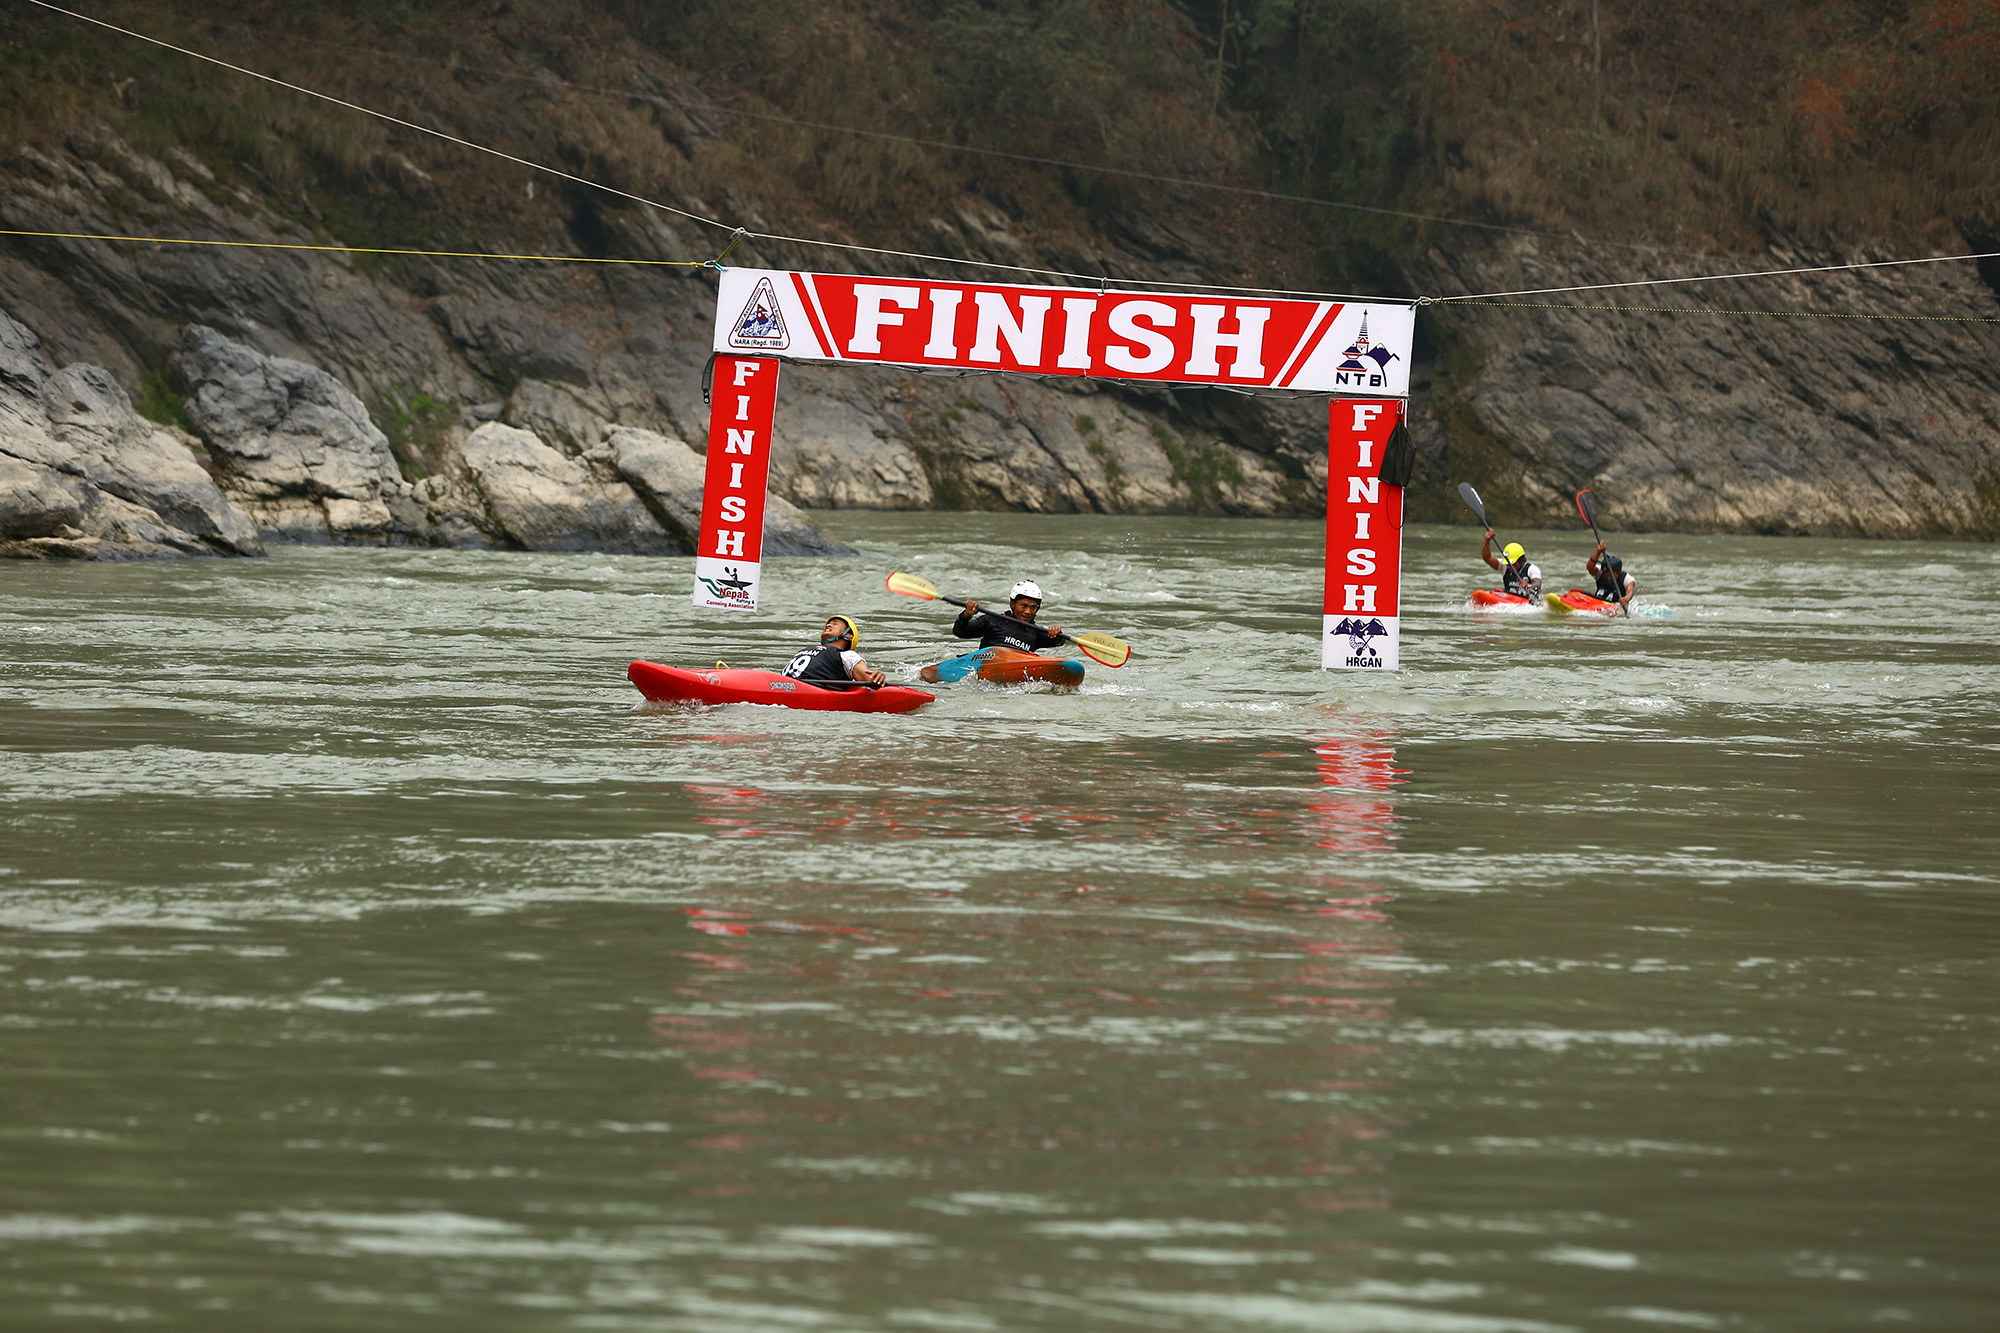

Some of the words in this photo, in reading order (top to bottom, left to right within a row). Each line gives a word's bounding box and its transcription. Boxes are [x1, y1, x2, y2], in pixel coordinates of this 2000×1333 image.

[848, 283, 1271, 379] FINISH
[1335, 371, 1382, 387] NTB
[715, 360, 760, 557] FINISH
[1343, 404, 1383, 612] FINISH
[719, 587, 749, 599] Nepal
[1004, 635, 1031, 651] HRGAN
[1346, 656, 1382, 668] HRGAN
